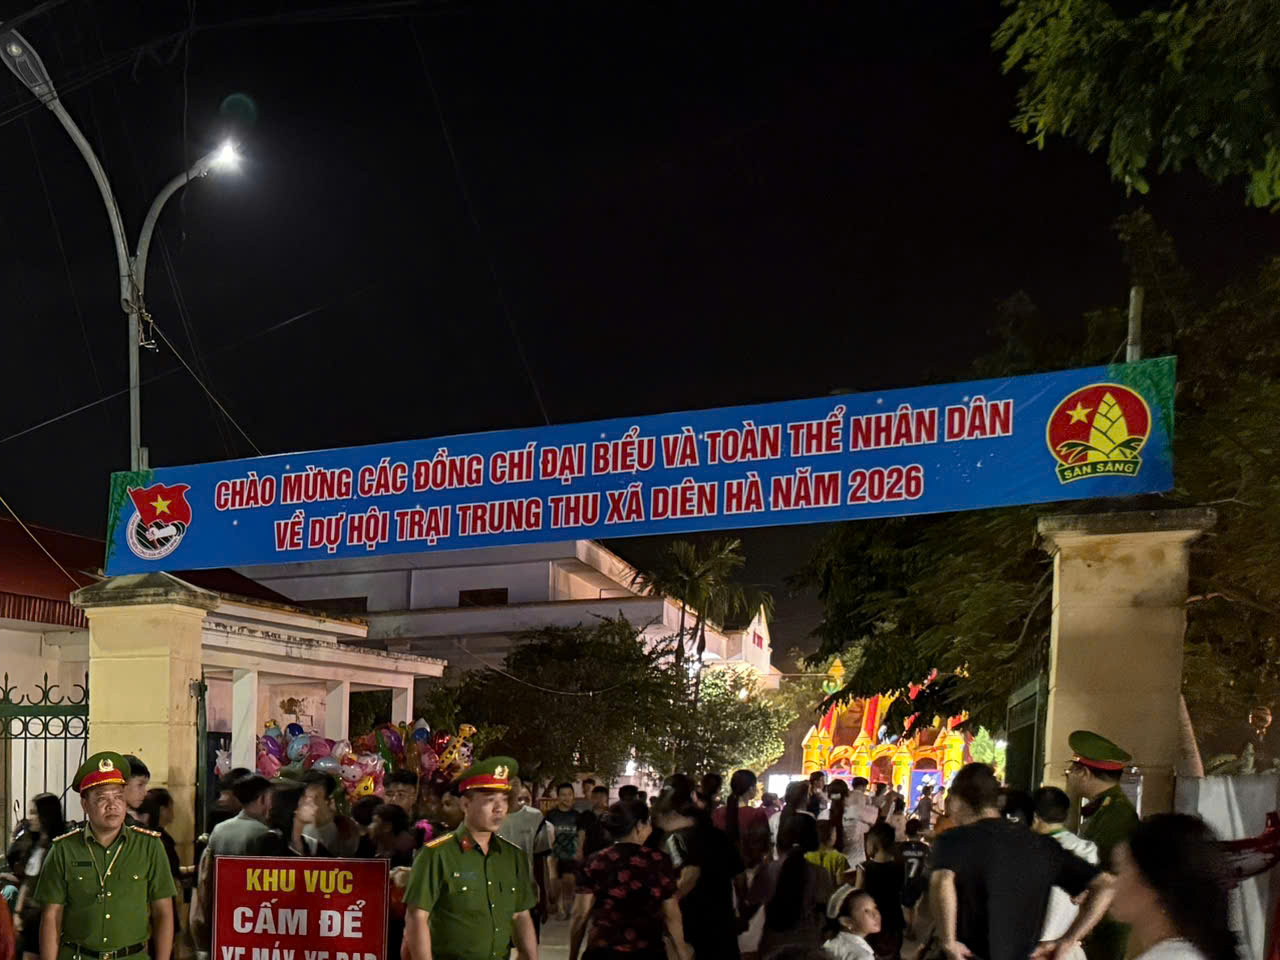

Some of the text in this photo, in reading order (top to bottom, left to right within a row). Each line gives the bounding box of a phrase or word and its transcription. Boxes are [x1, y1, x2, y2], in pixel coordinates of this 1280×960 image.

[214, 396, 1013, 510] CHÀO MỪNG CÁC ĐỒNG CHÍ ĐẠI BIỂU VÀ TOÀN THỂ NHÂN DÂN
[275, 463, 925, 553] VỀ DỰ HỘI TRẠI TRUNG THU XÃ DIÊN HÀ NĂM 2026
[246, 867, 353, 899] KHU VỰC
[907, 858, 920, 878] 7
[233, 898, 367, 938] CẤM ĐỂ
